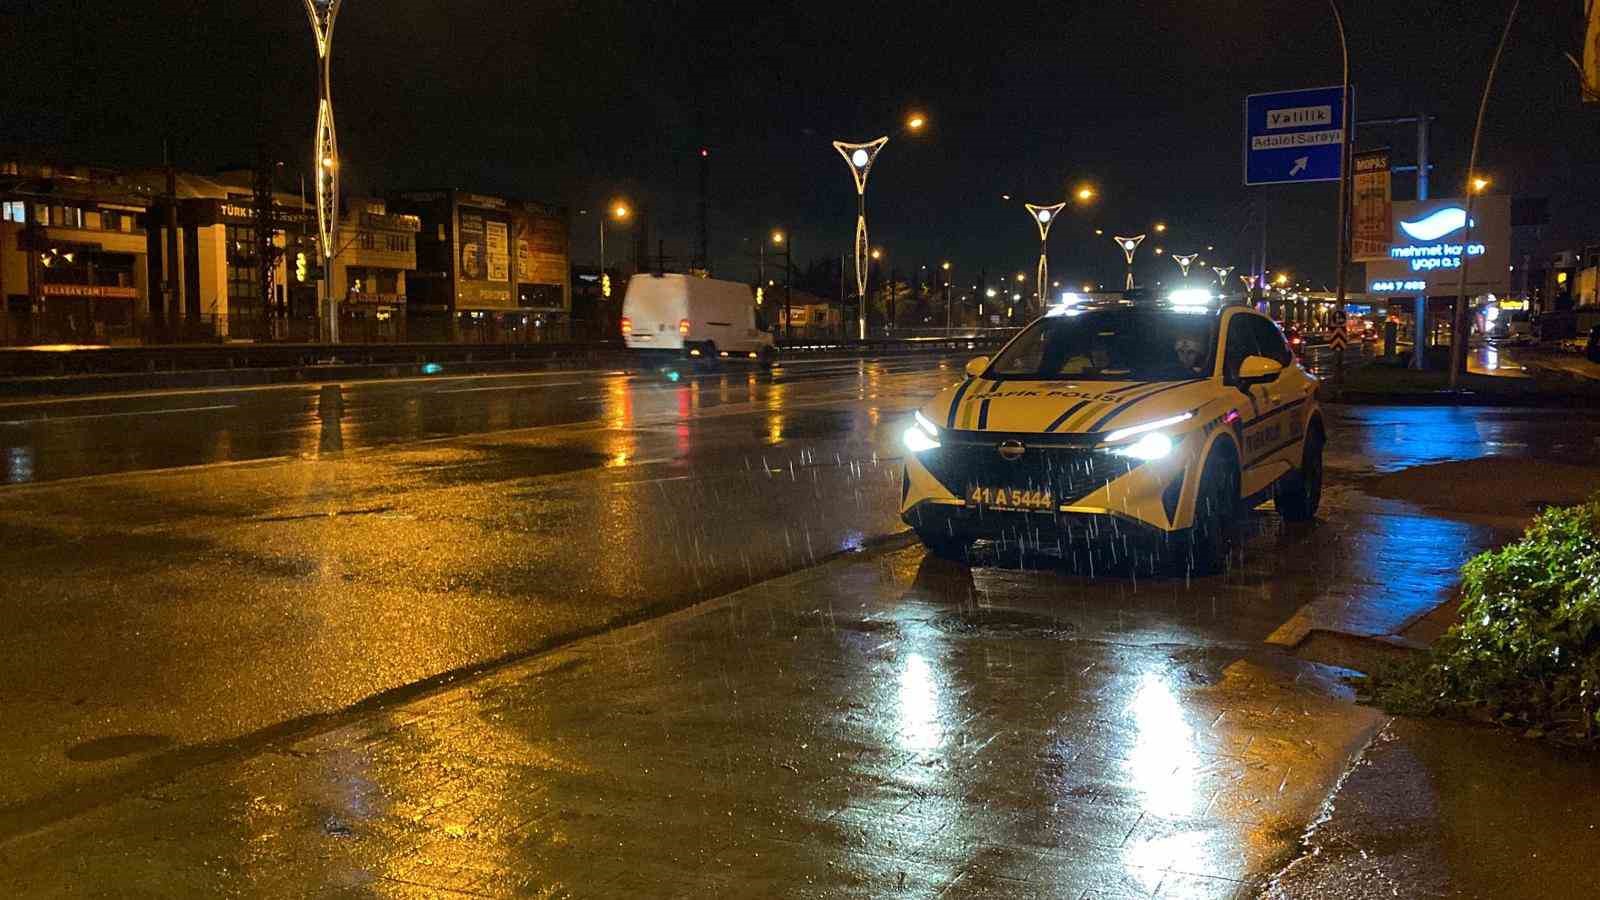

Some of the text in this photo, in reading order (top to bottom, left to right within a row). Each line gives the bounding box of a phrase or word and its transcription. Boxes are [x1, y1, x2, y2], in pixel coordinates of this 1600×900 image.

[1272, 110, 1327, 124] Valilik
[1391, 245, 1442, 257] mehmet
[971, 487, 1051, 508] 41 A 5444
